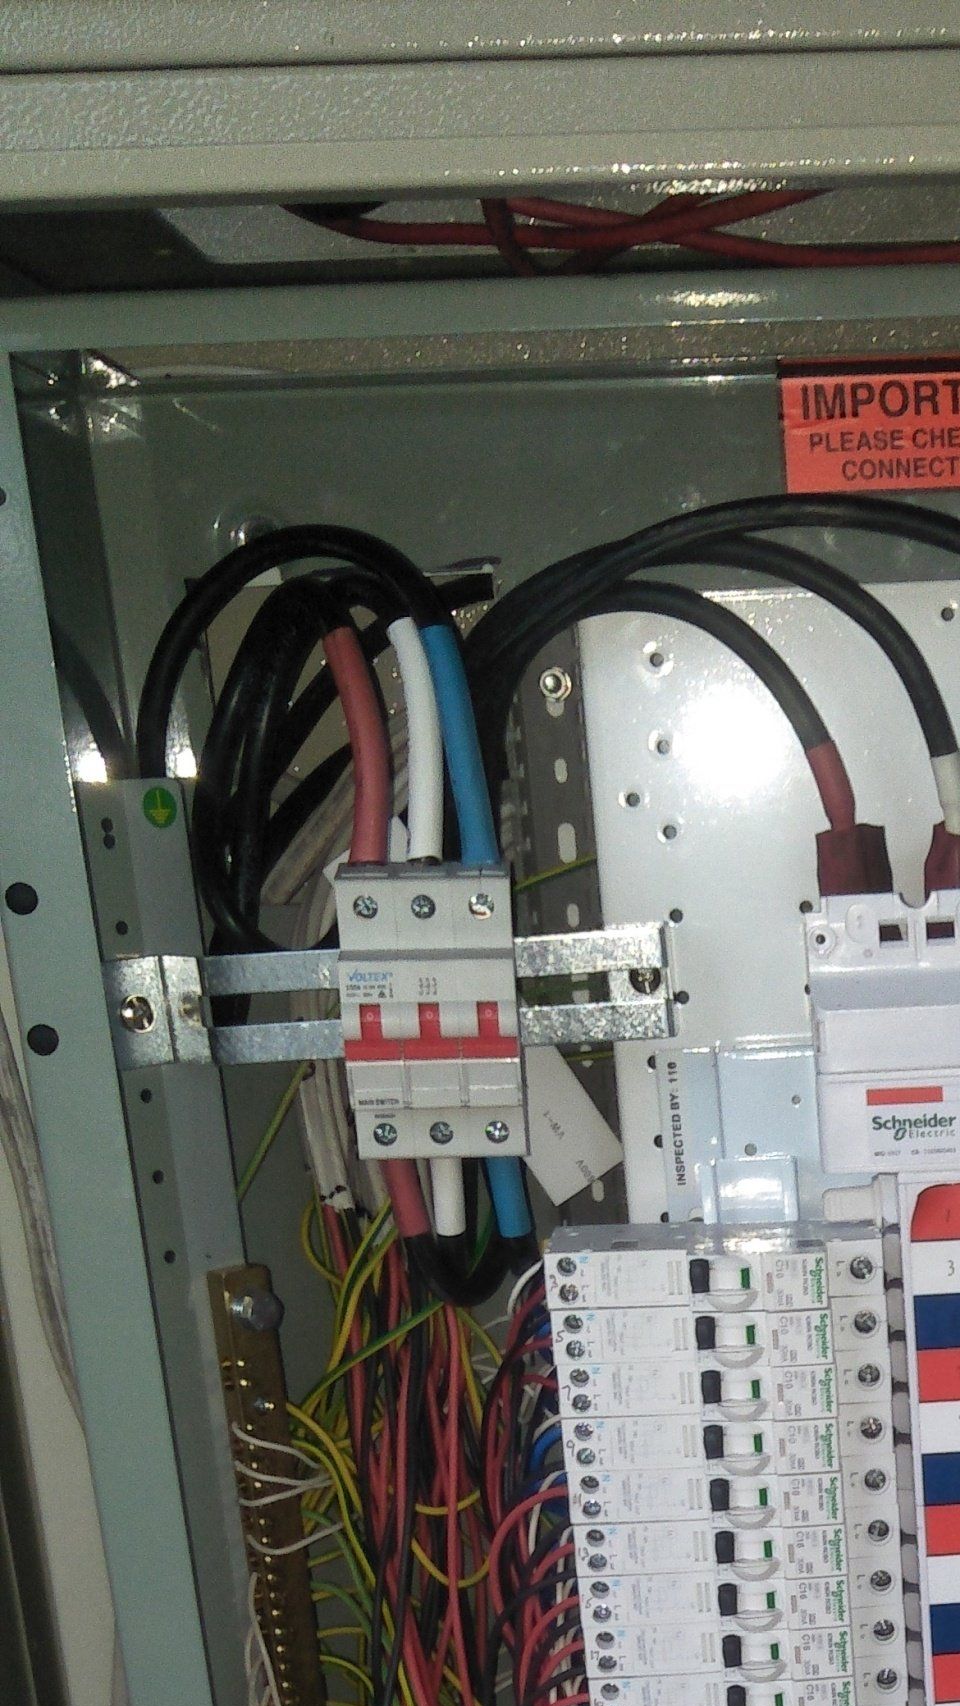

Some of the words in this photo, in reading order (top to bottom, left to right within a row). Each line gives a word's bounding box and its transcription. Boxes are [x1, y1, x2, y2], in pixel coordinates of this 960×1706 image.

[809, 428, 905, 454] PLEASE
[871, 1113, 957, 1132] Schneider
[671, 1114, 686, 1186] INSPECTED
[814, 1257, 824, 1305] Schneider
[947, 1260, 956, 1277] 3
[555, 1330, 565, 1344] 5
[818, 1313, 829, 1359] Schneider
[561, 1384, 571, 1402] 7
[823, 1368, 834, 1413] Schneider
[566, 1439, 575, 1457] 9
[824, 1423, 834, 1468] Schneider
[829, 1477, 839, 1520] Schneider
[833, 1528, 843, 1572] Schneider
[836, 1580, 845, 1622] Schneider
[838, 1630, 848, 1673] Schneider
